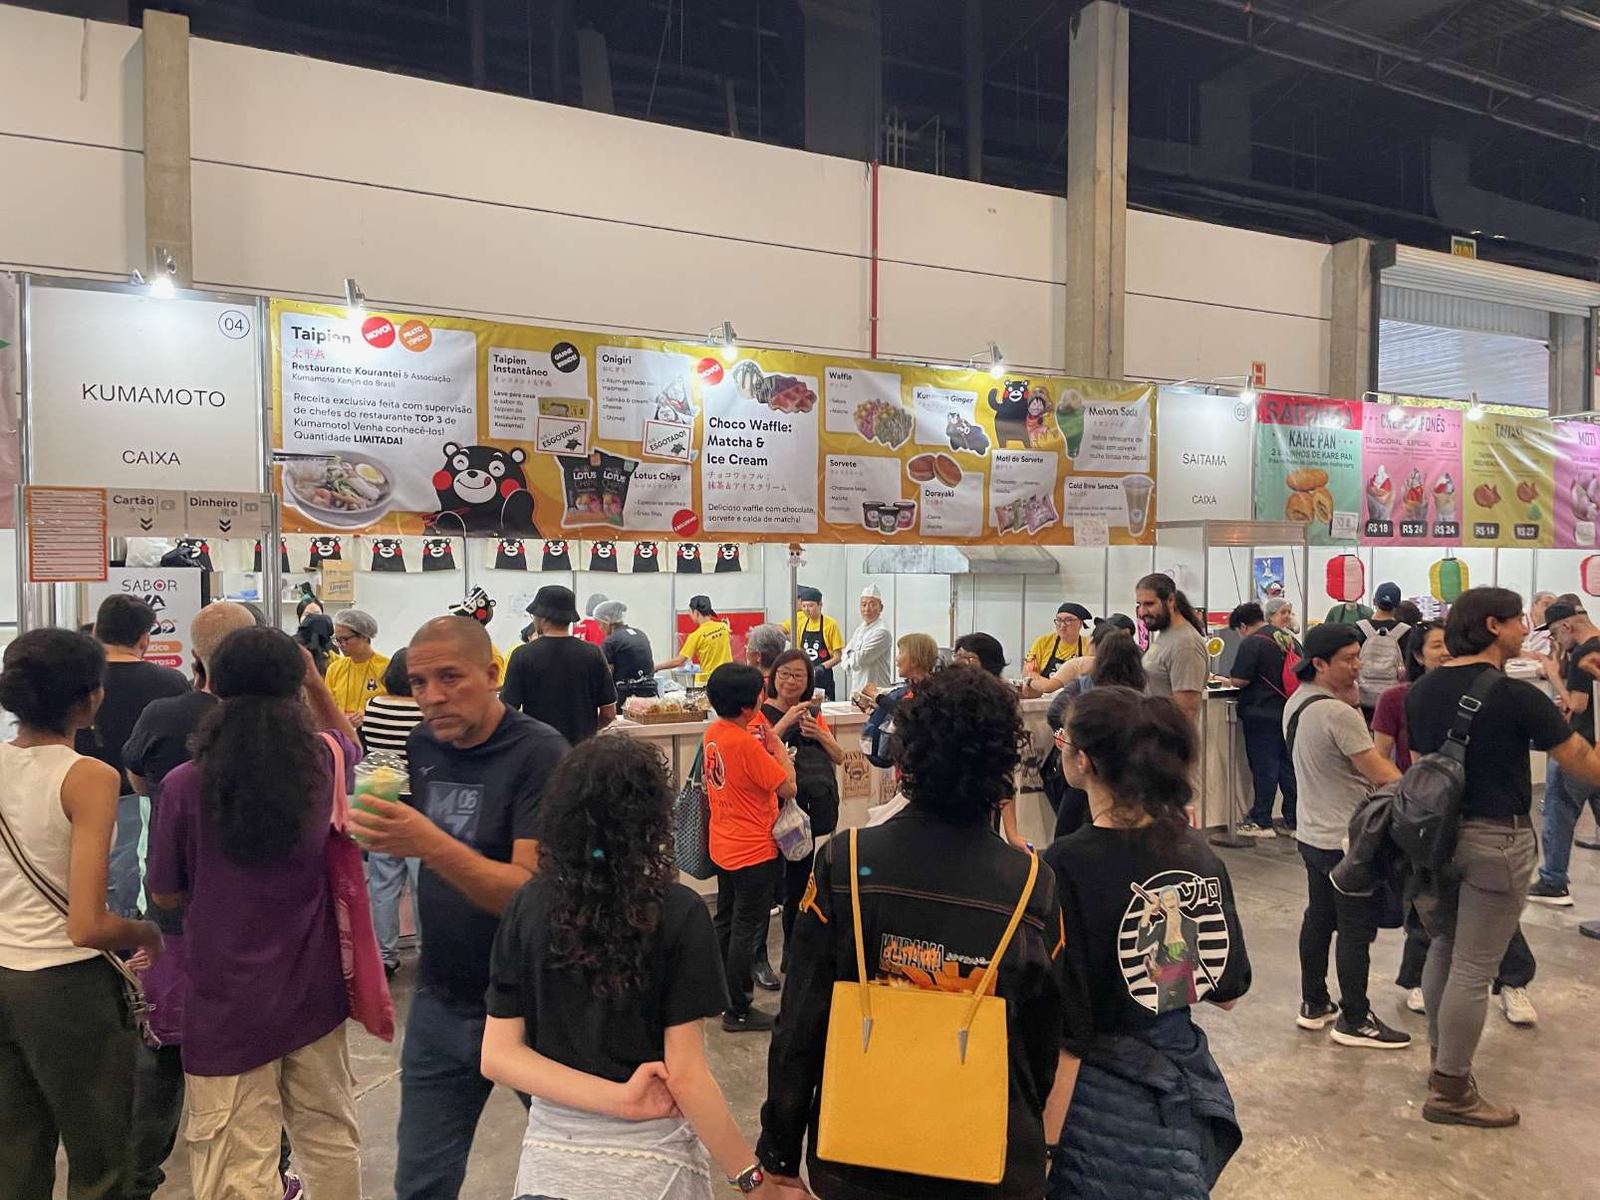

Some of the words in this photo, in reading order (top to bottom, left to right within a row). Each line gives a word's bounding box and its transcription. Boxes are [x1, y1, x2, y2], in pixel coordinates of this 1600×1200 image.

[224, 317, 243, 331] 04
[366, 324, 392, 340] NOVO!
[494, 354, 527, 366] Taipien
[602, 354, 632, 365] Onigiri
[292, 362, 352, 374] Restaurante
[355, 367, 401, 378] Kourantei
[411, 373, 451, 383] Associação
[493, 364, 548, 377] Instantâneo
[292, 373, 335, 383] Kumamoto
[337, 377, 361, 387] Kenjin
[375, 379, 396, 388] Brasil
[81, 383, 226, 407] KUMAMOTO
[950, 395, 973, 404] Ginger
[294, 393, 330, 403] Receita
[333, 397, 376, 407] exclusiva
[379, 400, 400, 409] feita
[425, 404, 472, 415] supervisão
[310, 407, 341, 417] chefes
[344, 409, 357, 418] do
[360, 411, 412, 421] restaurante
[415, 414, 434, 423] TOP
[437, 416, 443, 424] 3
[445, 416, 456, 425] de
[1089, 407, 1119, 416] Melon
[1267, 401, 1352, 427] SAITA
[294, 418, 351, 431] Kumamoto!
[354, 422, 384, 432] Venha
[386, 424, 445, 436] conhecê-los!
[709, 417, 746, 430] Choco
[749, 420, 792, 433] Waffle:
[294, 431, 351, 444] Quantidade
[354, 435, 403, 445] LIMITADA!
[542, 424, 582, 448] ESGOTADO!
[649, 430, 687, 451] ESGOTADO!
[707, 435, 752, 448] Matcha
[756, 438, 764, 448] &
[1289, 430, 1315, 448] KARE
[1318, 432, 1336, 449] PAN
[122, 449, 181, 465] CAIXA
[707, 453, 725, 464] Ice
[729, 454, 768, 467] Cream
[1021, 455, 1044, 463] Sorvete
[1182, 453, 1228, 466] SAITAMA
[1312, 450, 1320, 458] DE
[1321, 451, 1339, 459] KARE
[829, 460, 857, 468] Sorvete
[573, 471, 597, 480] LOTUS
[634, 471, 657, 480] Lotus
[659, 472, 681, 482] Chips
[113, 494, 154, 506] Cartão
[925, 490, 955, 498] Dorayaki
[1191, 495, 1217, 505] CAIXA
[190, 497, 238, 508] Dinheiro
[708, 503, 740, 511] Delicioso
[743, 504, 763, 512] waffle
[1402, 525, 1413, 534] R$
[1414, 524, 1423, 533] 24
[122, 580, 177, 592] SABOR
